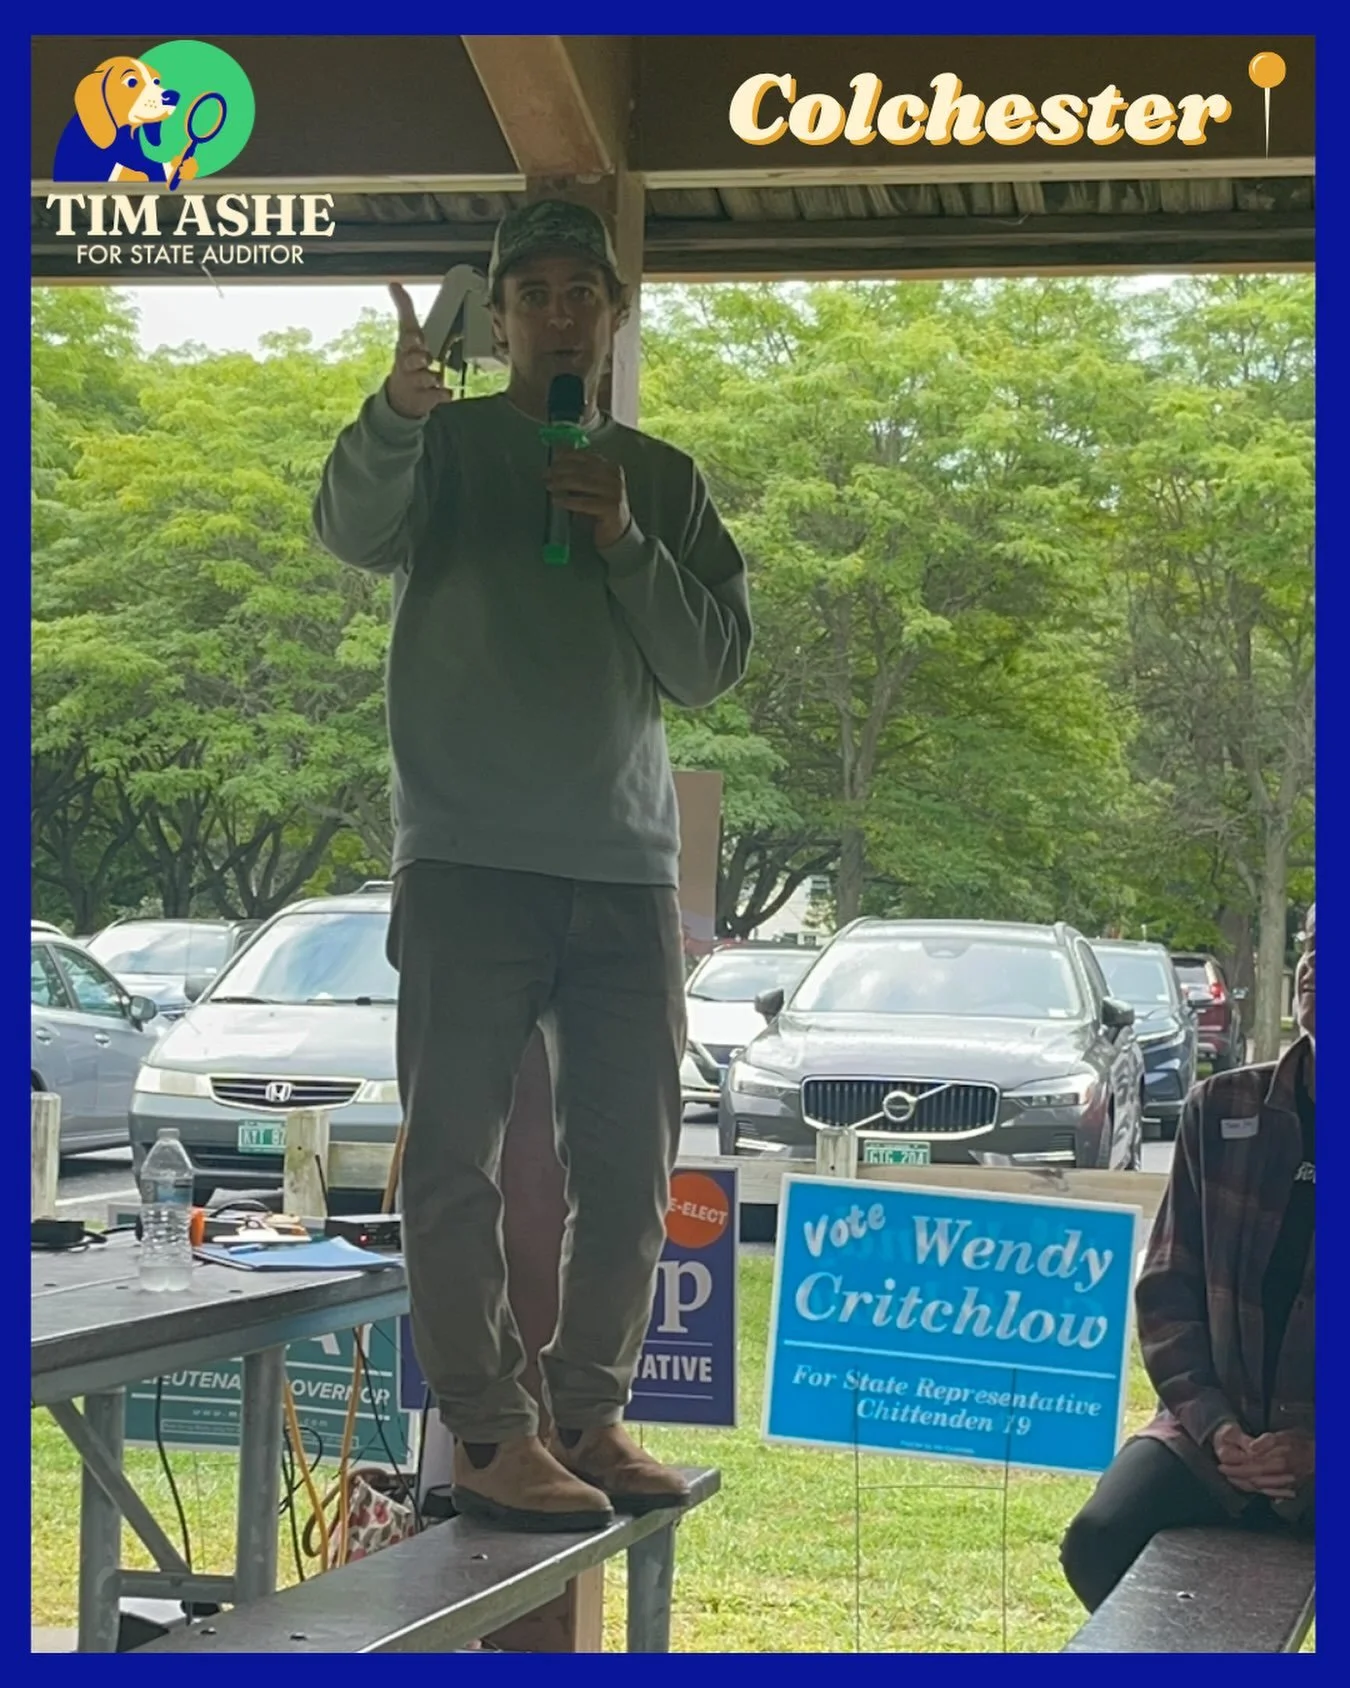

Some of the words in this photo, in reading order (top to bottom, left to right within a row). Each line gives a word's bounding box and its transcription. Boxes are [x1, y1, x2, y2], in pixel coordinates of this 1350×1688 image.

[804, 1202, 886, 1257] Vote
[912, 1215, 1114, 1293] Wendy
[795, 1271, 1108, 1349] Critchlow
[792, 1364, 836, 1388] For
[843, 1369, 908, 1396] State
[916, 1377, 1102, 1417] Representative
[856, 1397, 993, 1434] Chittenden
